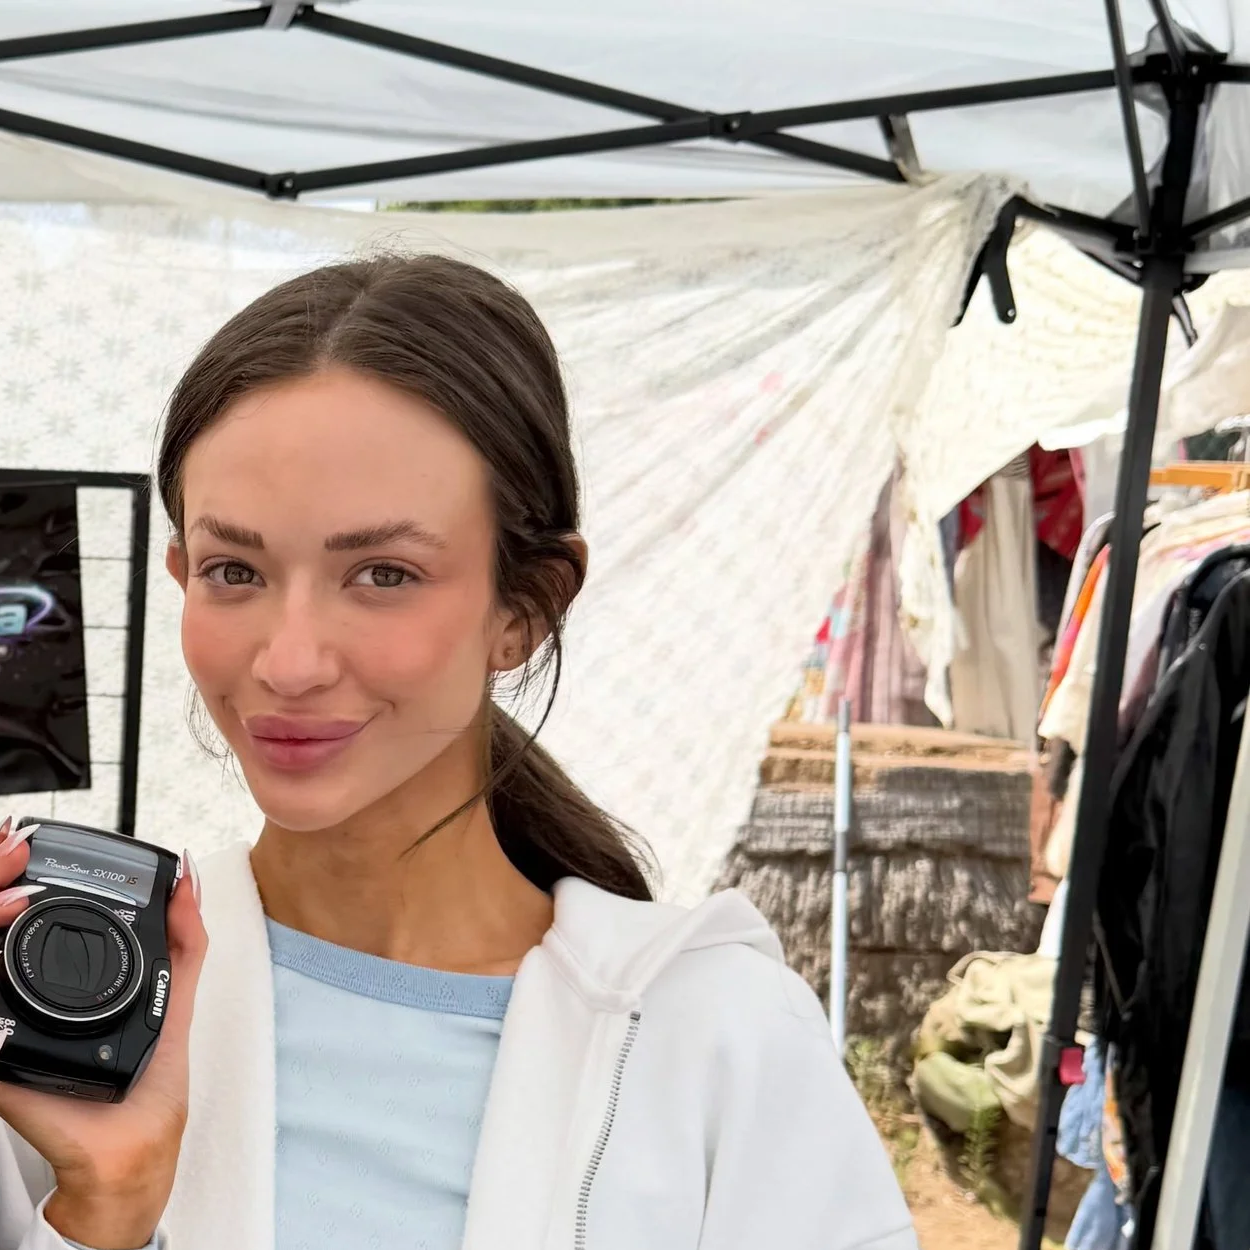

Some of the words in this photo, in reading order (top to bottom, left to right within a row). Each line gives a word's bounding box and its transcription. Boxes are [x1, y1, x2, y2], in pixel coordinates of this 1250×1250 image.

[44, 857, 90, 875] PowerShot
[91, 868, 126, 882] SX100
[152, 969, 170, 1017] Canon
